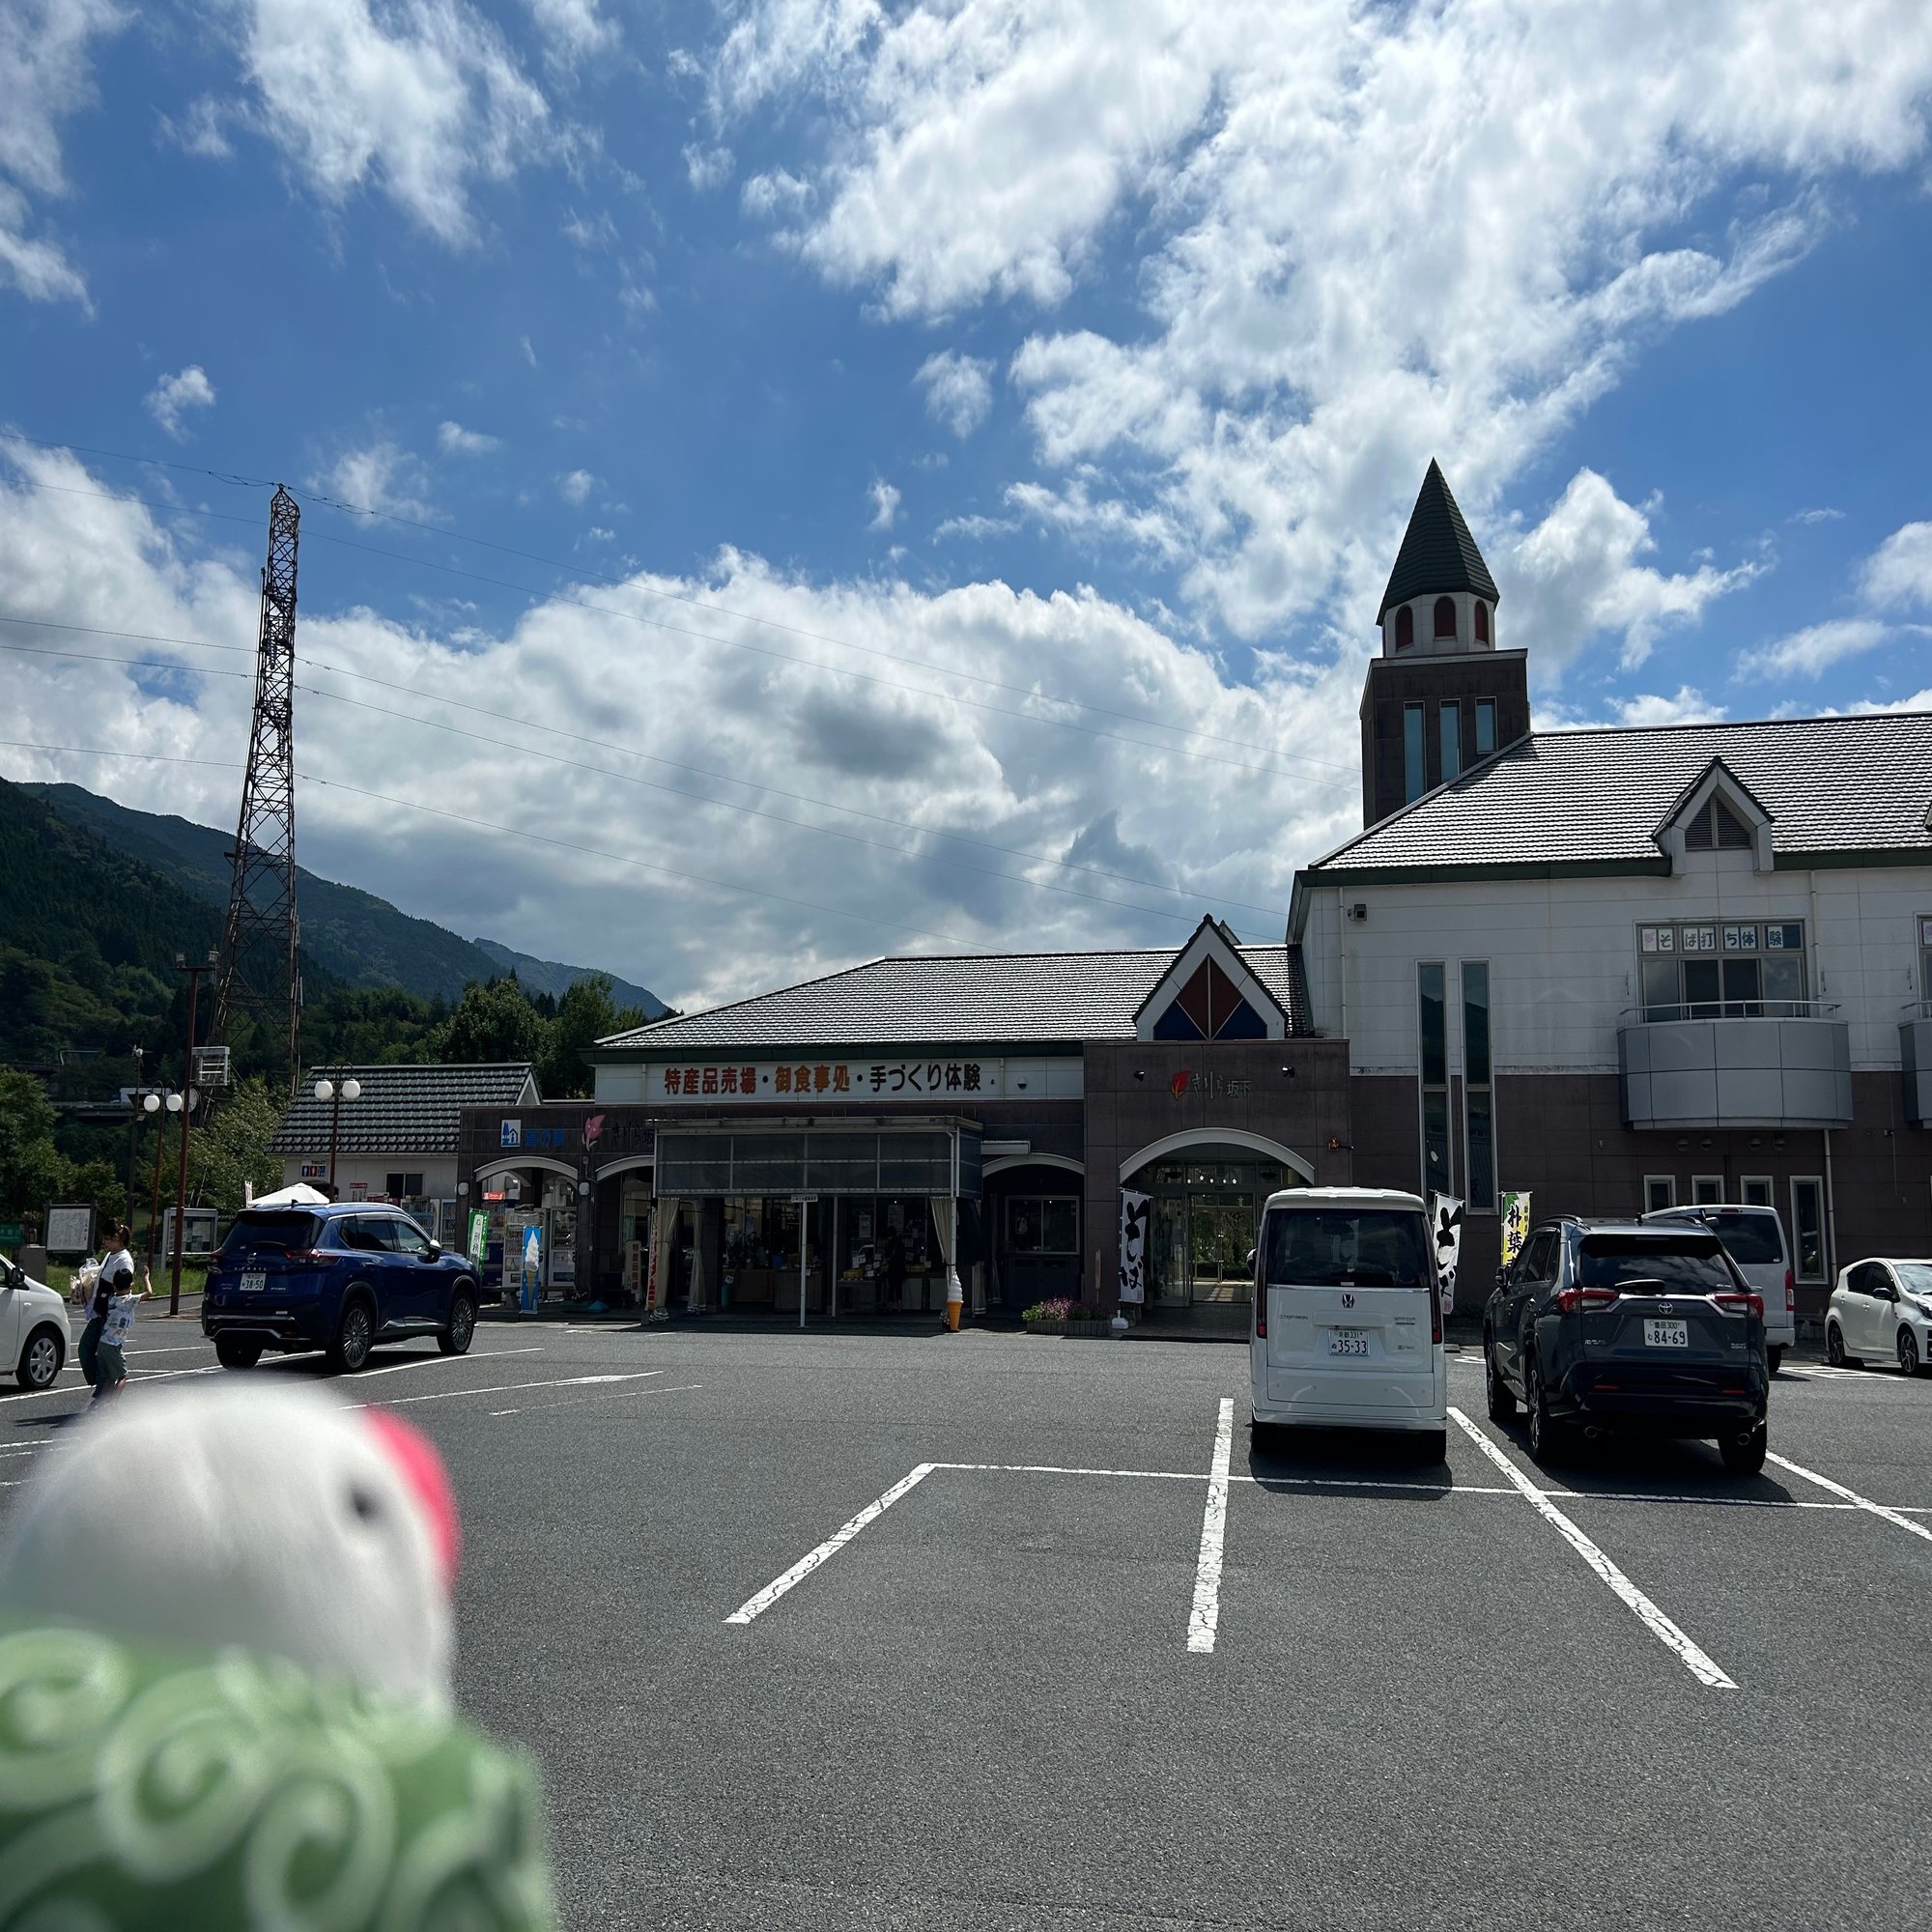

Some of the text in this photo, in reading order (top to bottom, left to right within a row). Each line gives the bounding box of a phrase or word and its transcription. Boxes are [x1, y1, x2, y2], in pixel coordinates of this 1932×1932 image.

[1660, 930, 1782, 948] そば打ち体験
